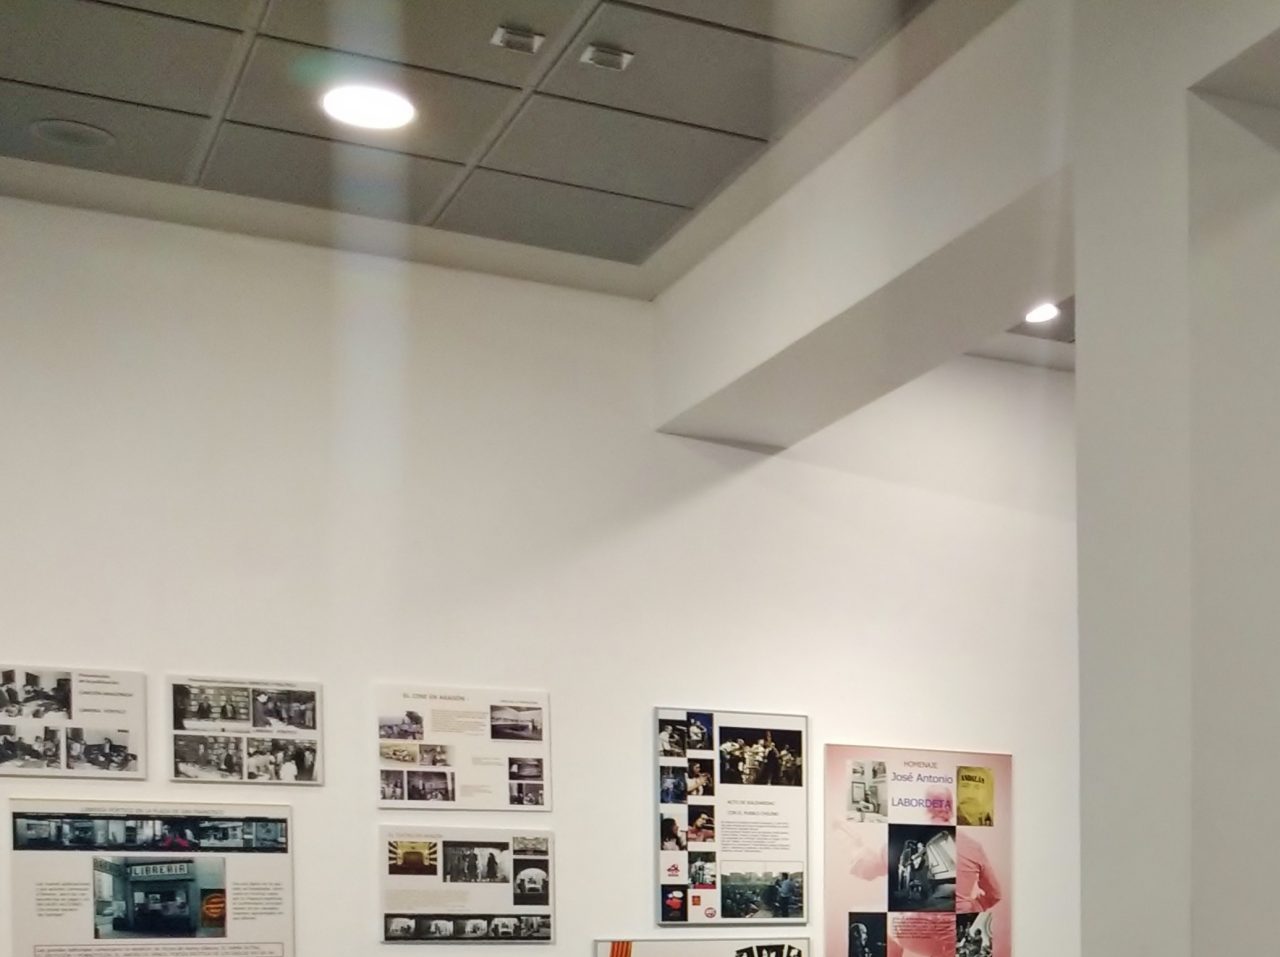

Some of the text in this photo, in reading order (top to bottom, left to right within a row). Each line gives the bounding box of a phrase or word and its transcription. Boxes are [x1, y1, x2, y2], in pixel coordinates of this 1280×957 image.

[903, 761, 938, 769] HOMENAJE
[892, 772, 954, 784] José Antonio
[891, 797, 953, 809] LABORDETA
